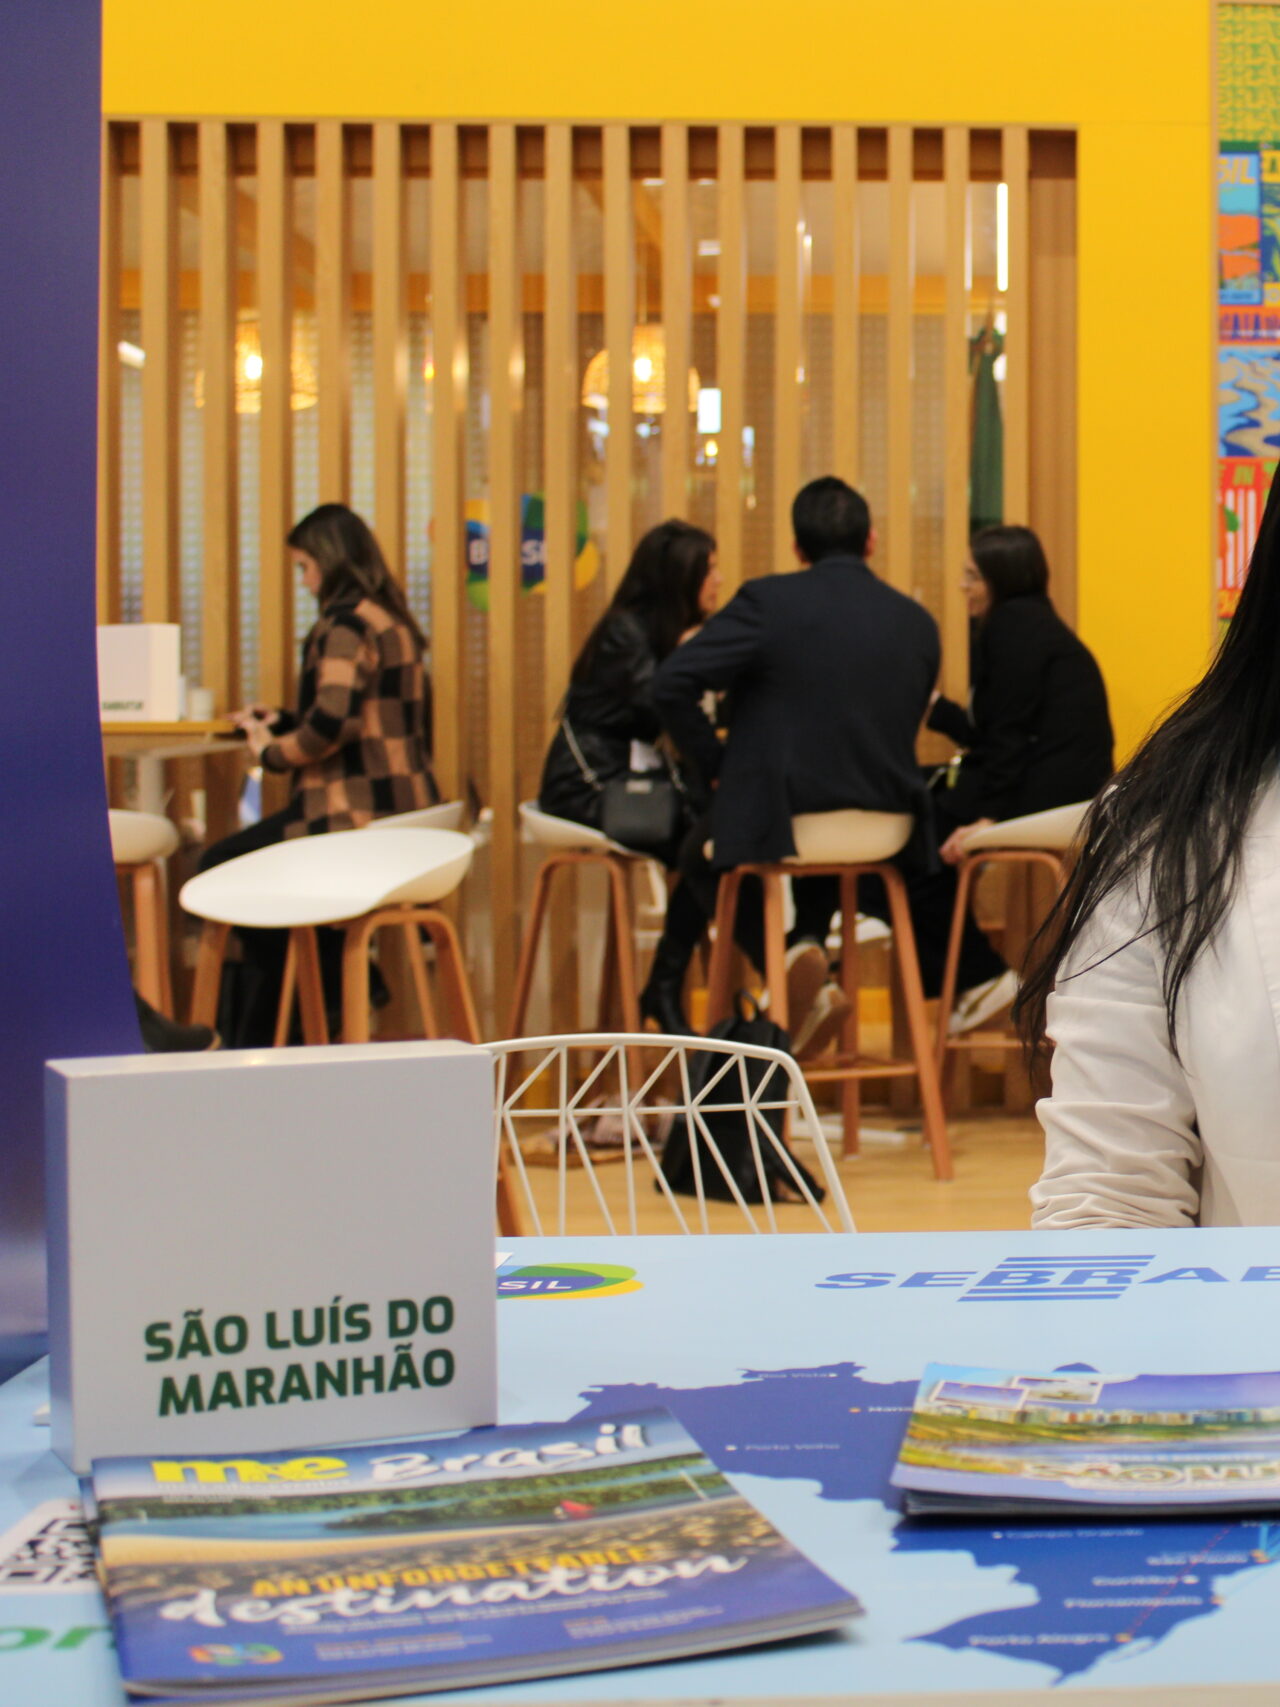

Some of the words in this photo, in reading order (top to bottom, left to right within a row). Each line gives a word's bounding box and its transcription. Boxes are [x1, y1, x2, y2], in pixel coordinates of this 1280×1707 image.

[144, 1308, 249, 1364] SÃO
[264, 1295, 373, 1352] LUÍS
[388, 1293, 457, 1338] DO
[158, 1341, 457, 1419] MARANHÃO
[369, 1421, 653, 1485] Brasil
[158, 1553, 749, 1627] destination
[251, 1578, 311, 1598] AN
